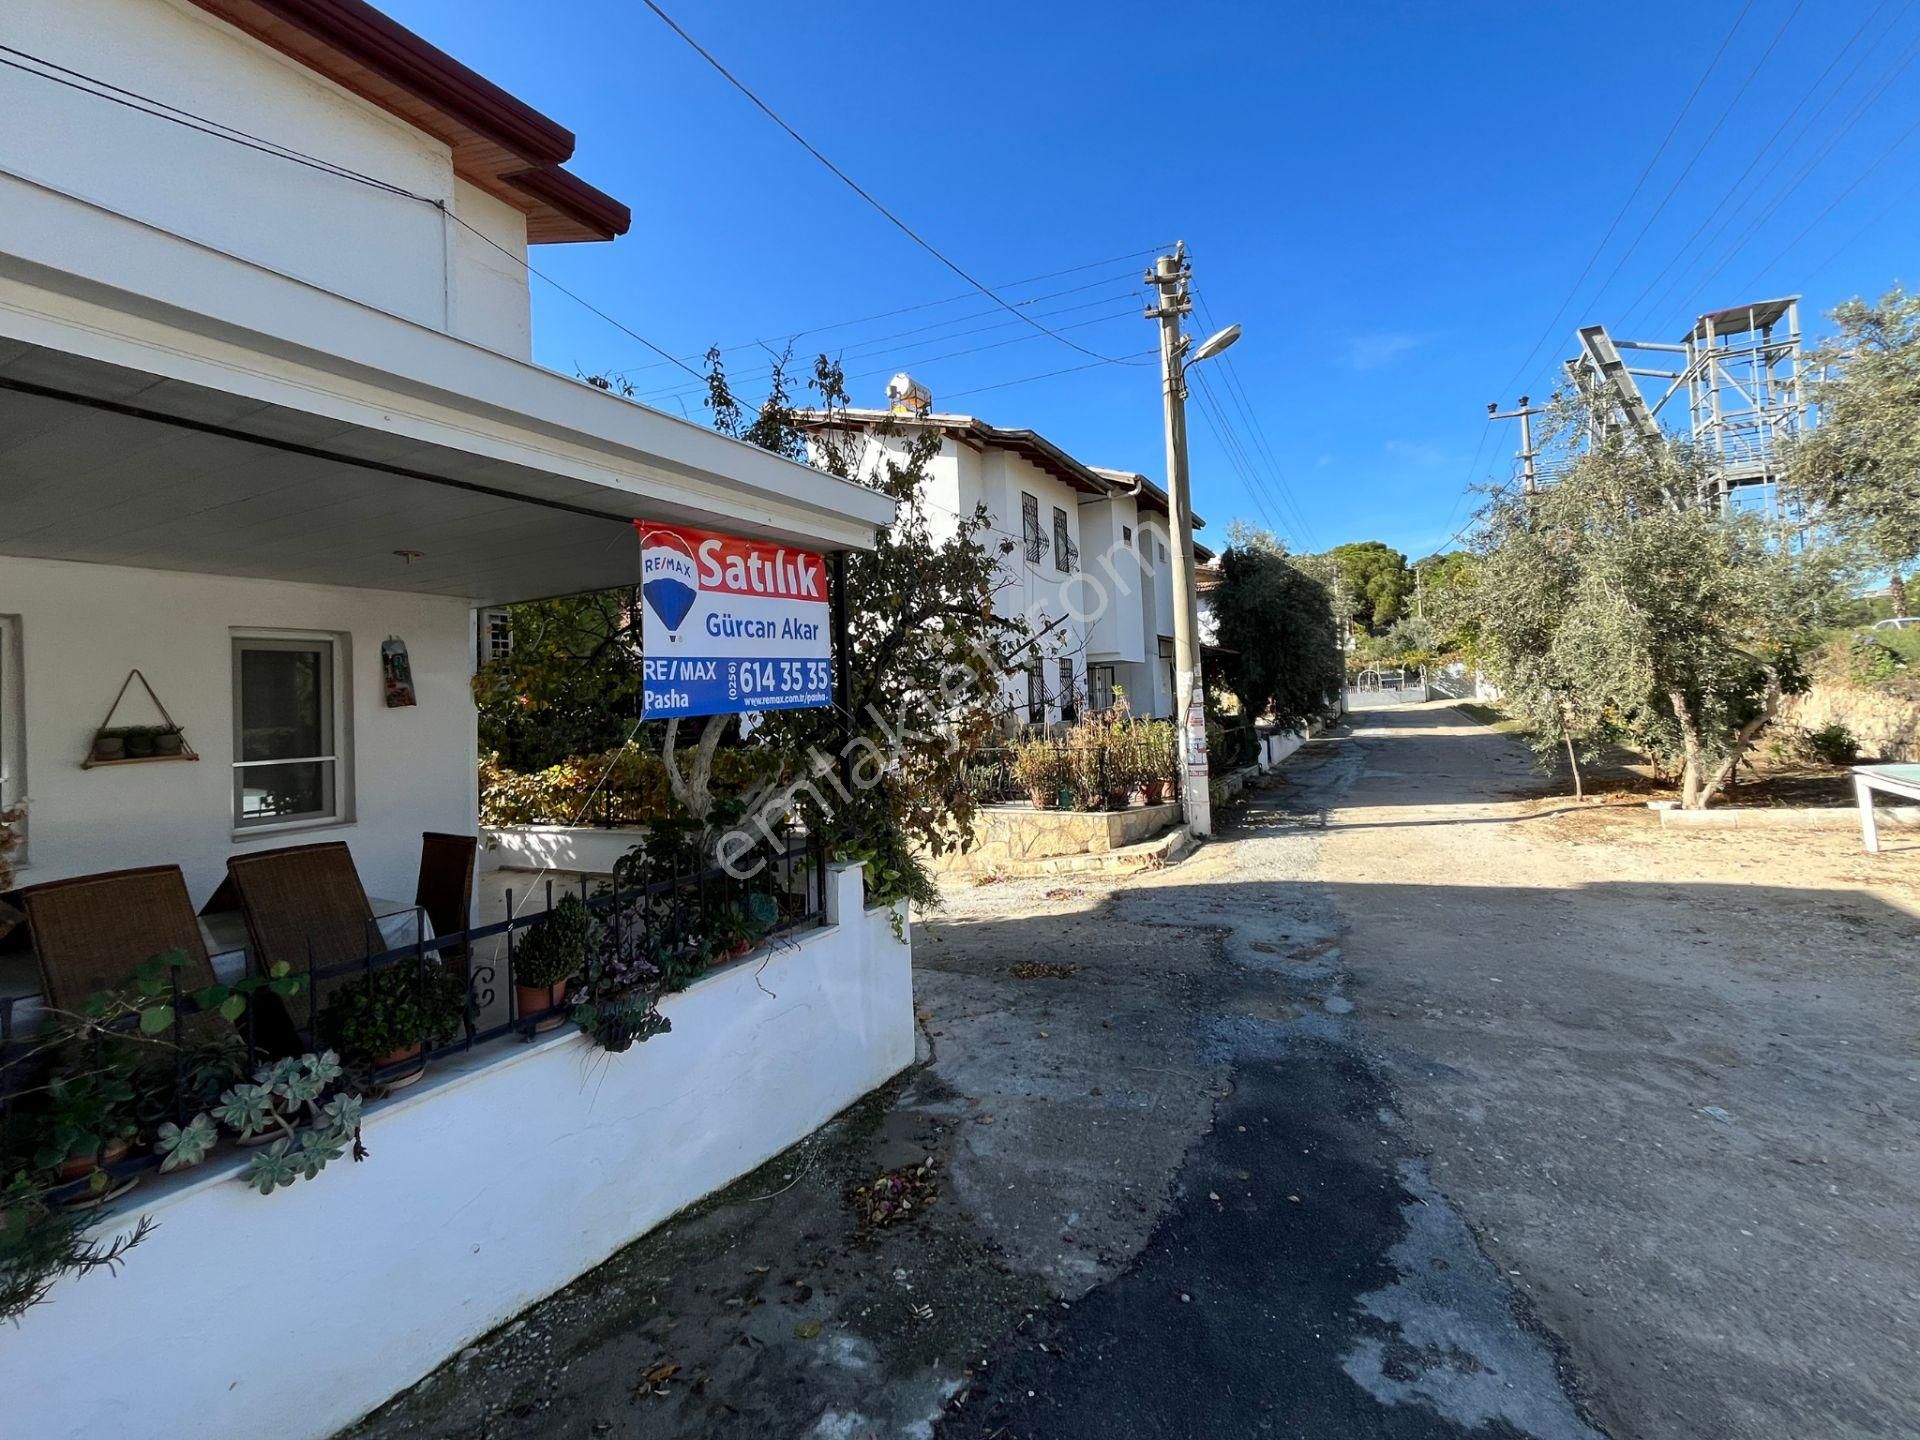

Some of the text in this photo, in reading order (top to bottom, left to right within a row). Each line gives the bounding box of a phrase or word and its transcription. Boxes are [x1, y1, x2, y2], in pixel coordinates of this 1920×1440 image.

[645, 557, 691, 578] RE/MAX
[699, 539, 819, 597] Satılık
[706, 612, 819, 640] Gürcan Akar
[644, 661, 717, 681] RE/MAX
[728, 662, 738, 700] (0256)
[740, 662, 828, 693] 614 35 35
[644, 689, 689, 710] Pasha
